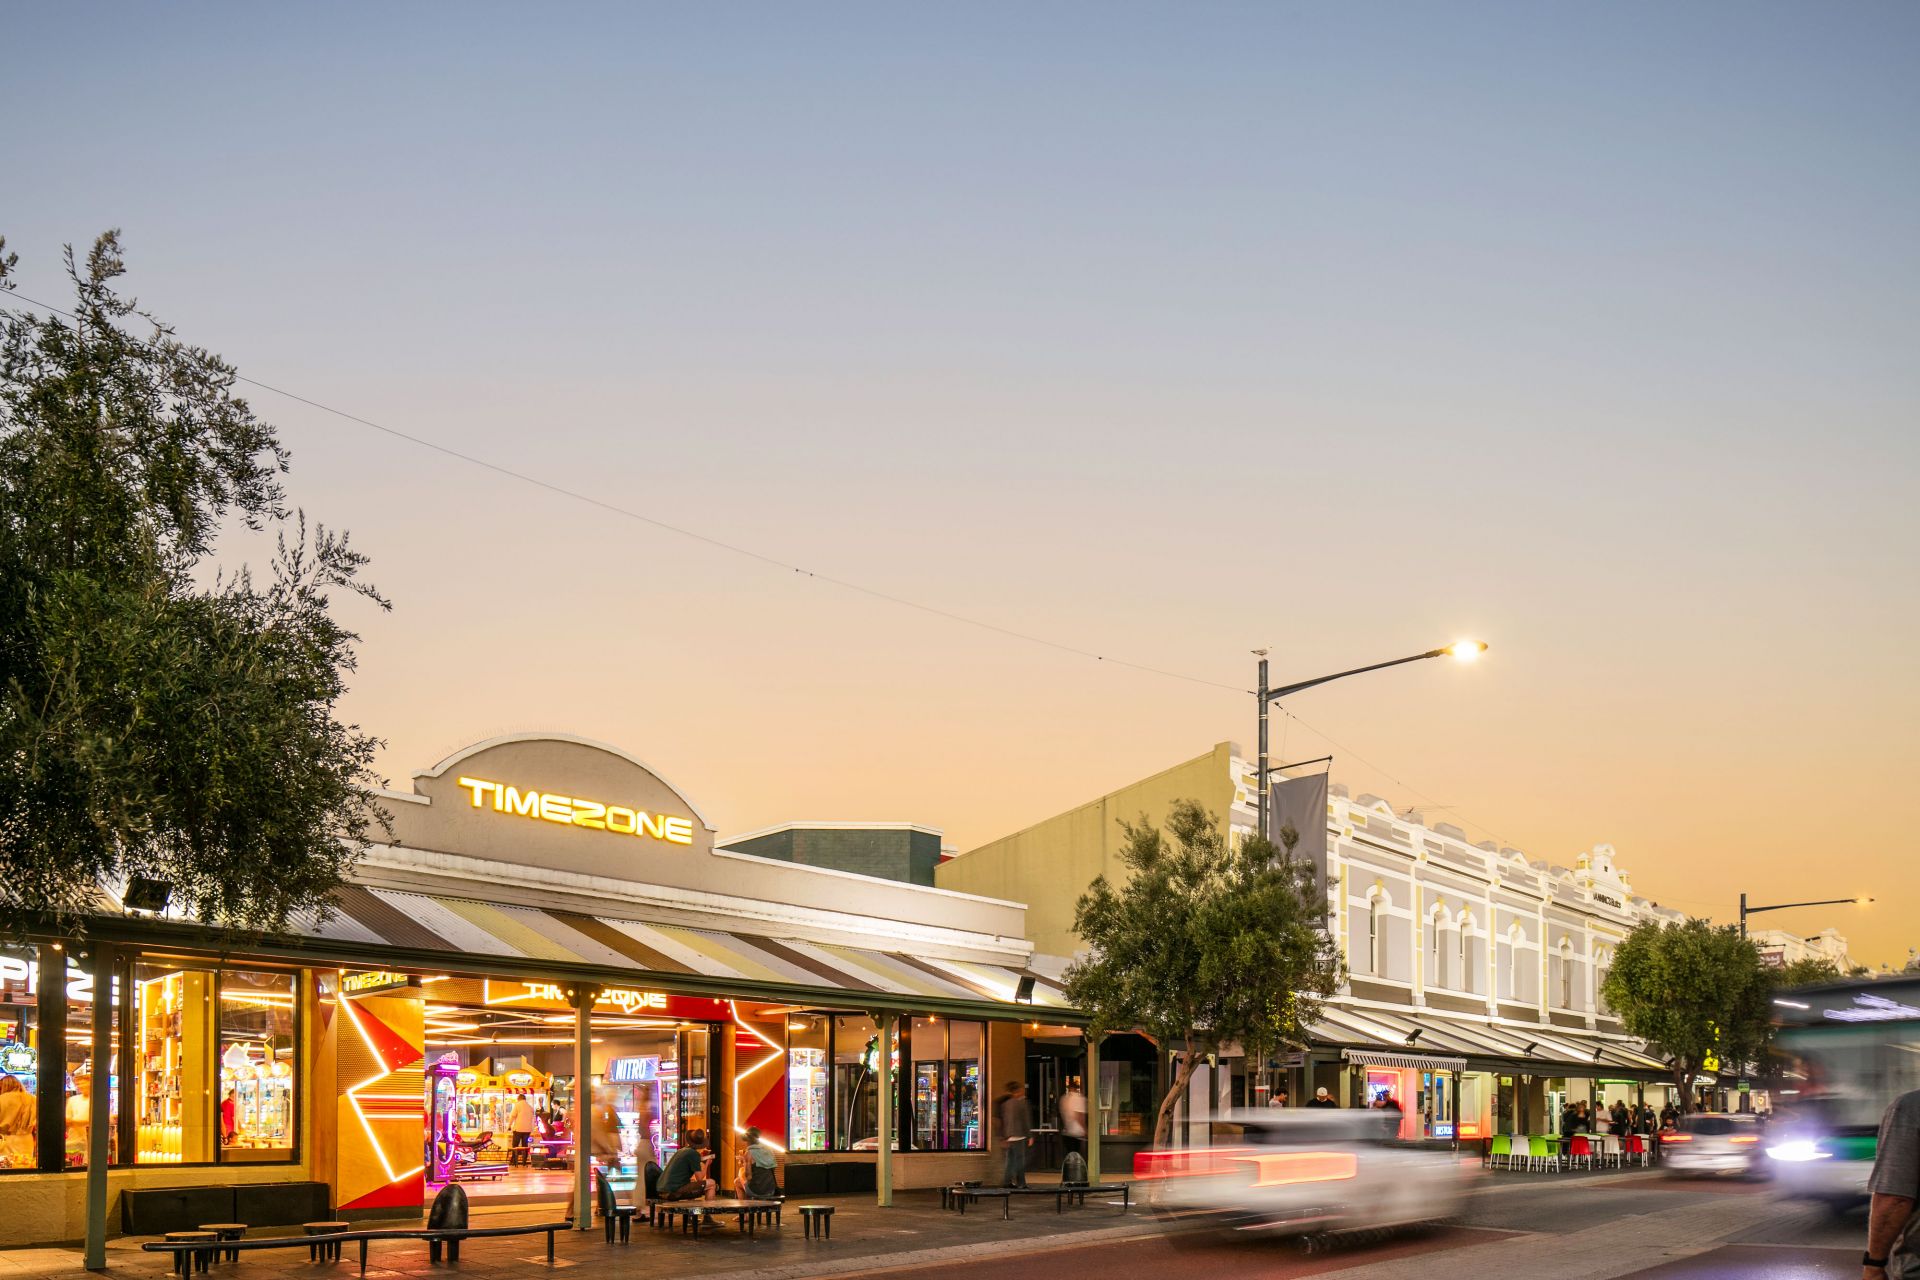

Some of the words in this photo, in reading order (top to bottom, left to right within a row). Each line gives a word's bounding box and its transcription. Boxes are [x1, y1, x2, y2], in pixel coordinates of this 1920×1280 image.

[459, 776, 693, 844] TIMEZONE
[522, 982, 667, 1009] TIMZONE
[615, 1058, 647, 1080] NITRO
